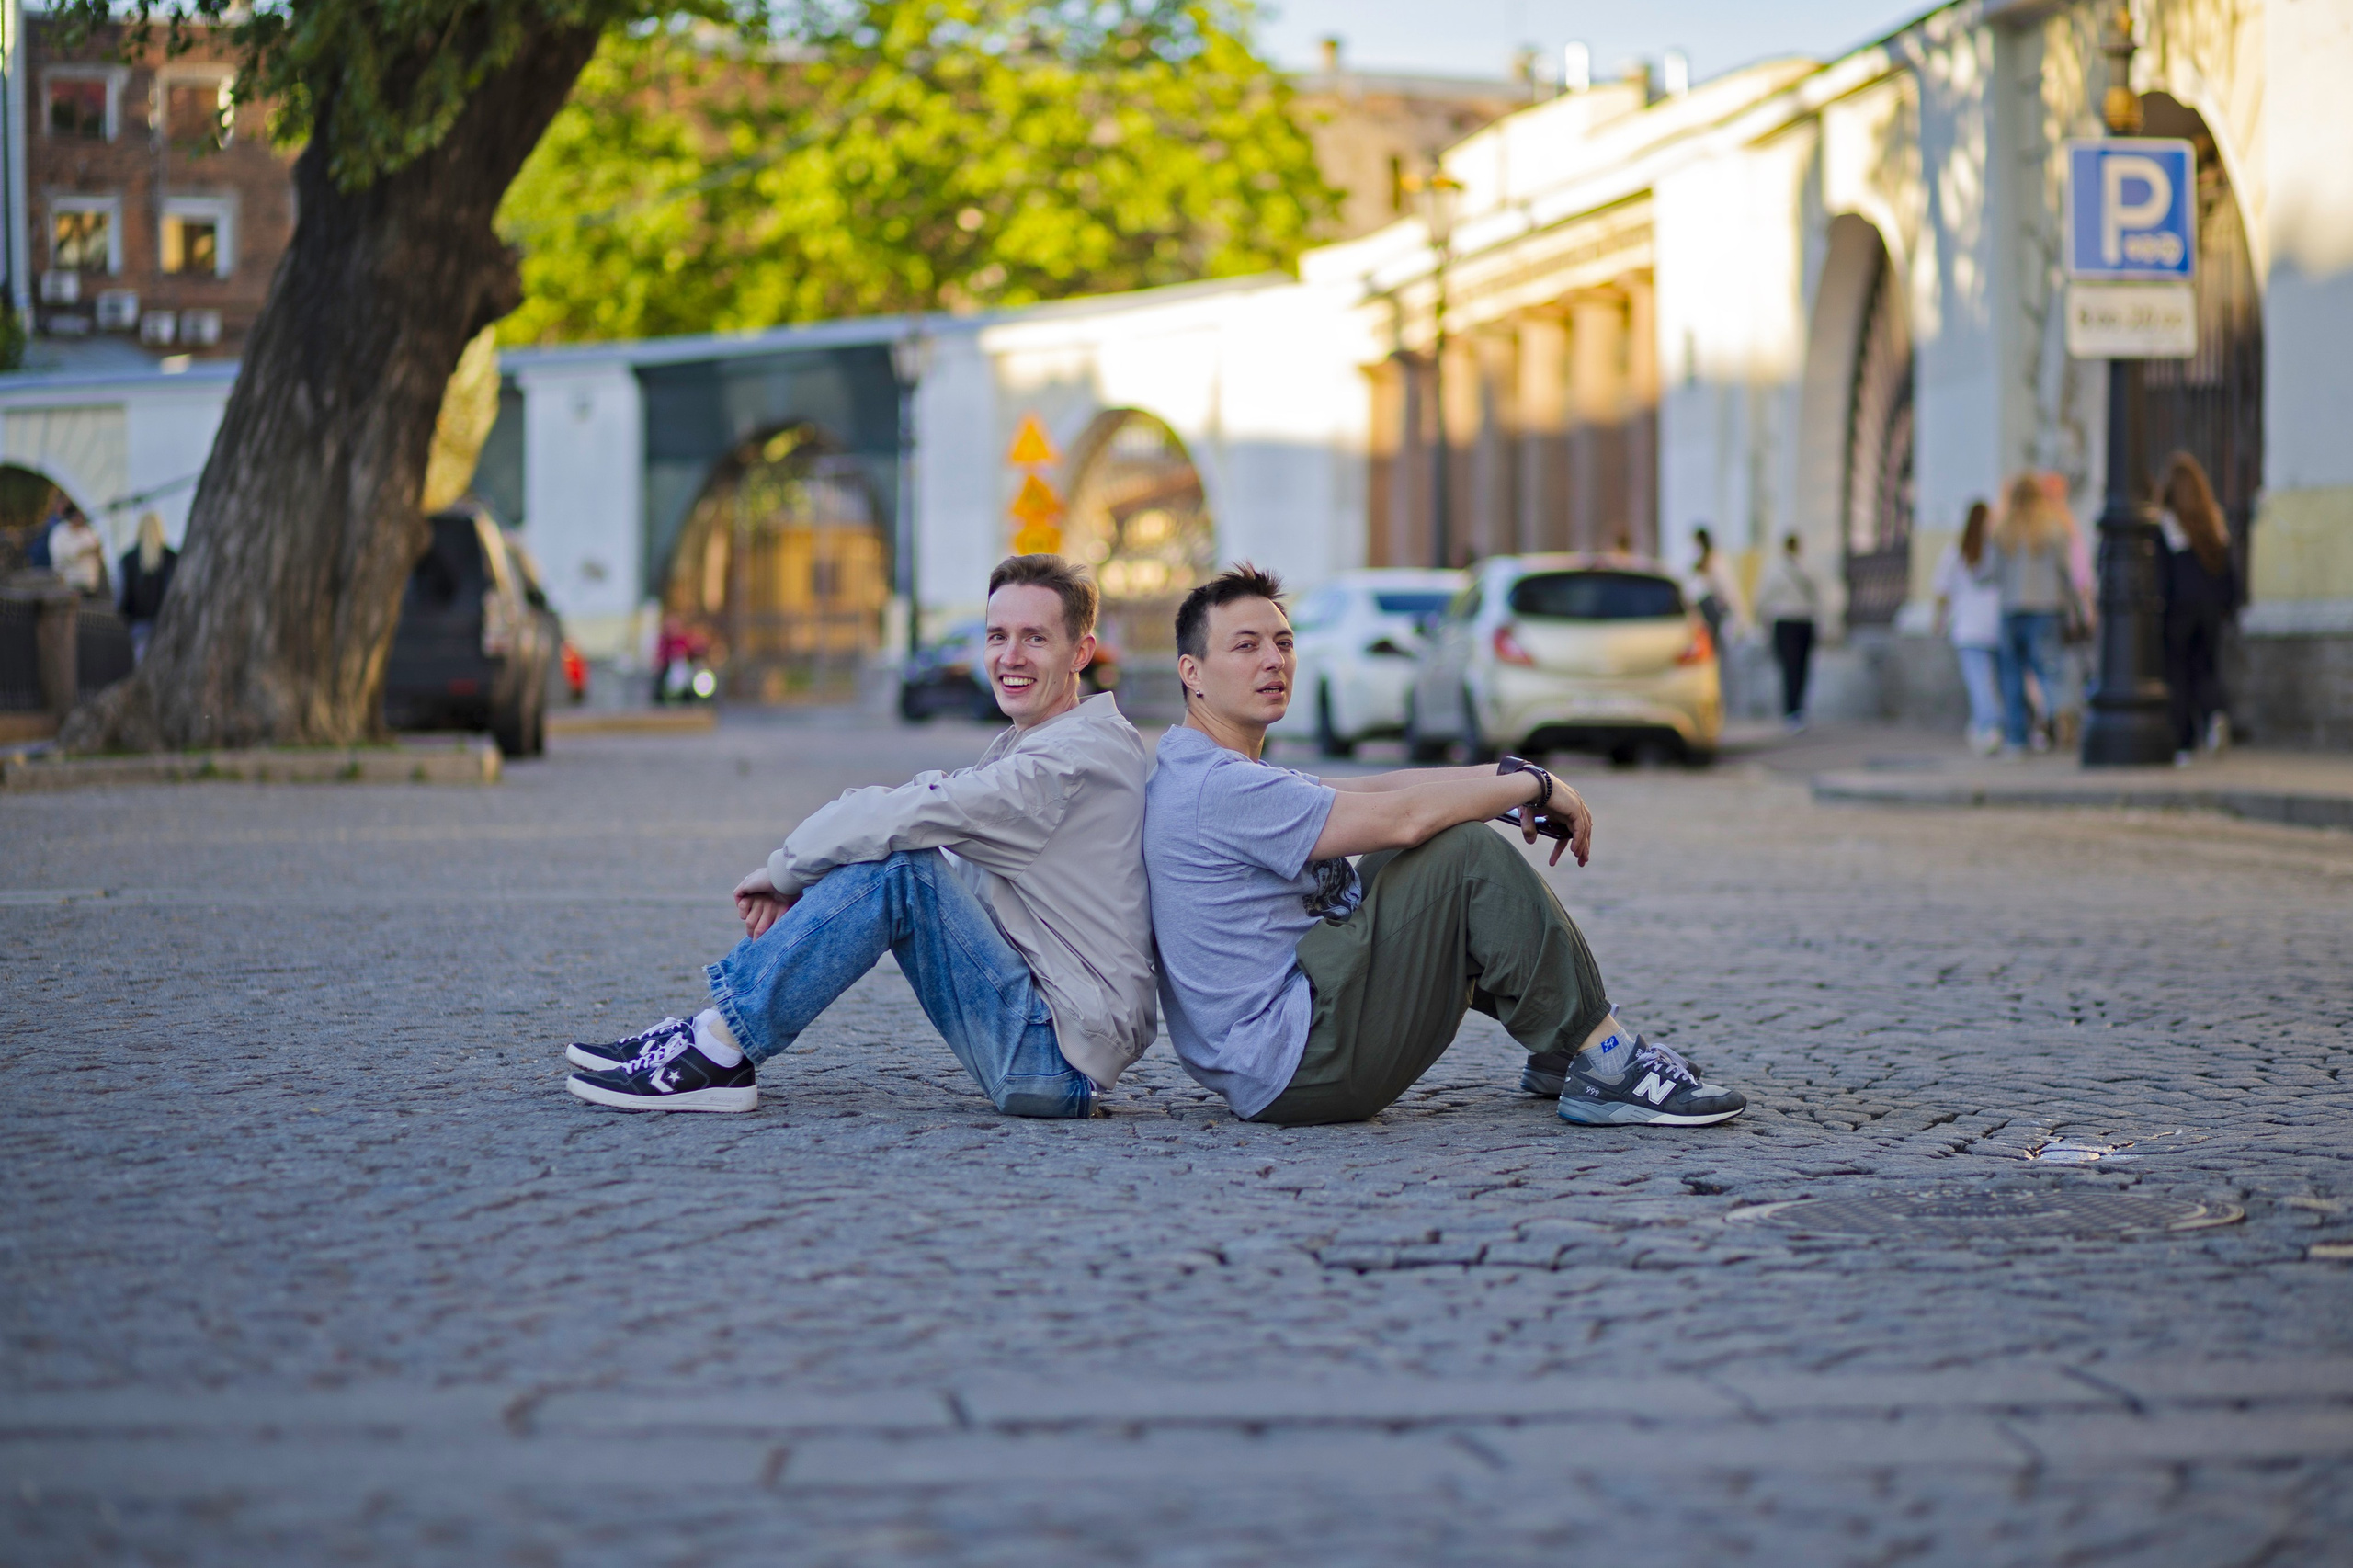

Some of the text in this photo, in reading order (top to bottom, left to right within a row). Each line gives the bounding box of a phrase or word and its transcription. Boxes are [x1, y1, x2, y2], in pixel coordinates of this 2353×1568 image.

[2102, 154, 2172, 266] P
[1586, 1085, 1600, 1096] 999
[1632, 1072, 1677, 1105] N
